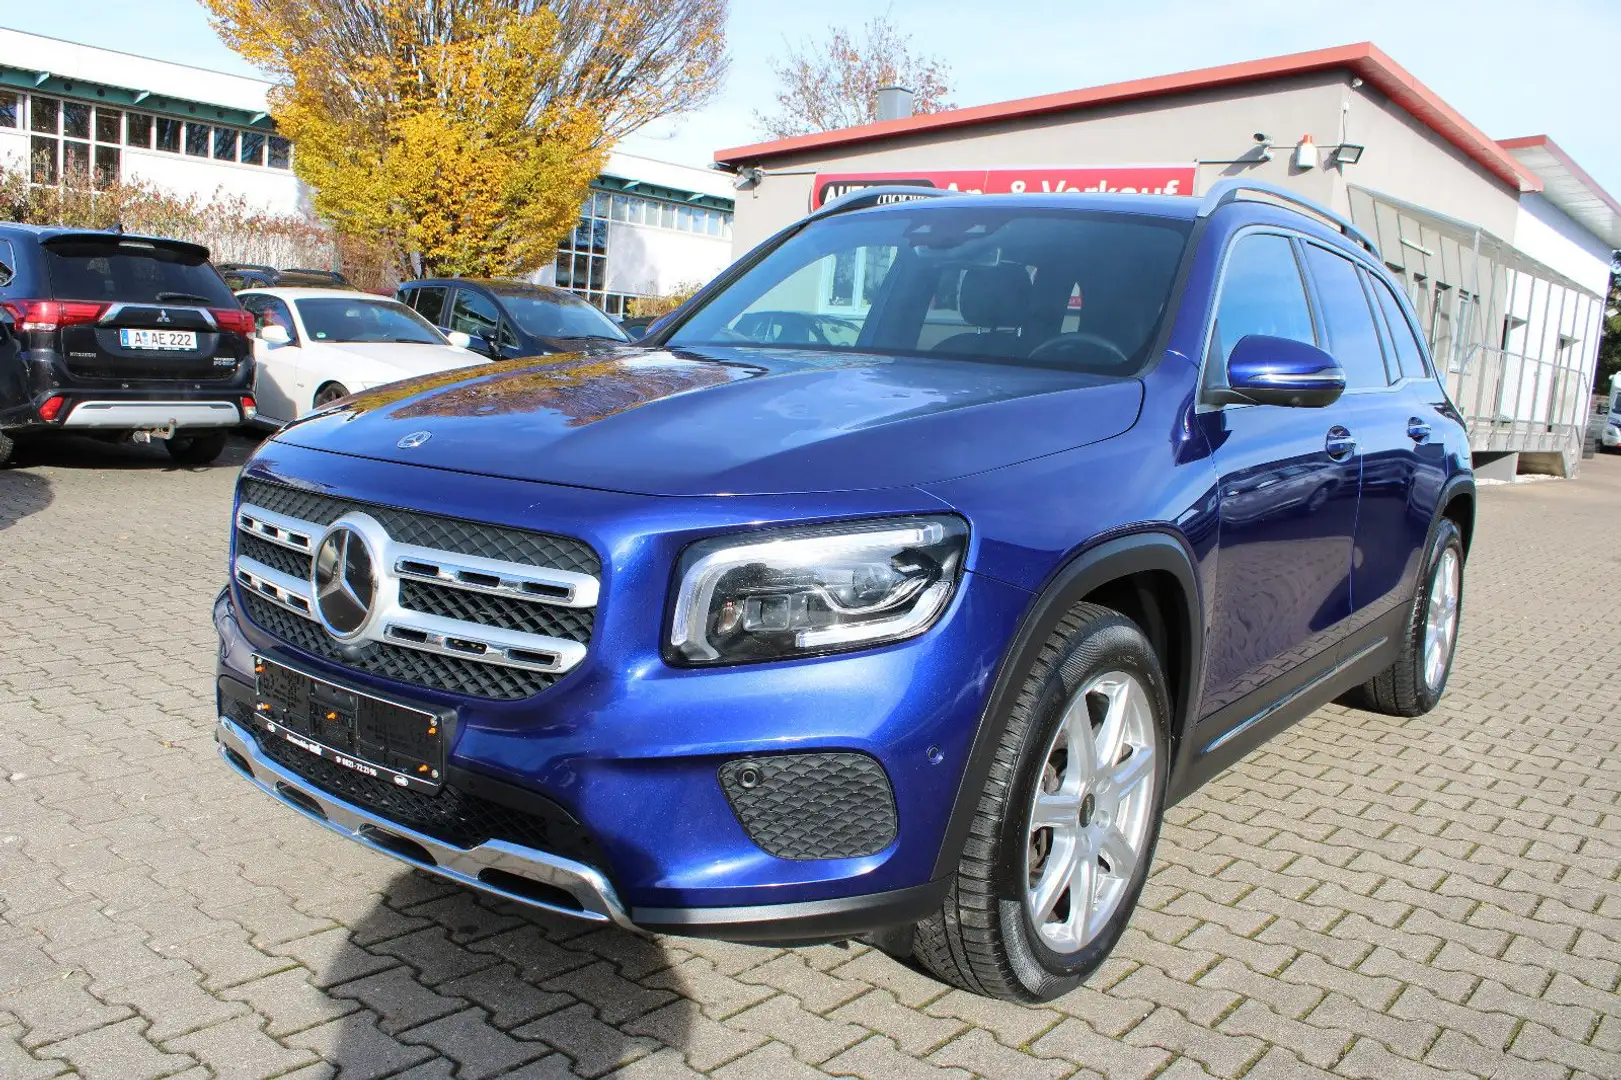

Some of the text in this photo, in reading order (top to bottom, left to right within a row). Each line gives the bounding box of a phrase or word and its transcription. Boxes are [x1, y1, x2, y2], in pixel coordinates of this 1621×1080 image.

[824, 186, 873, 205] AU
[135, 332, 191, 346] A AE 222
